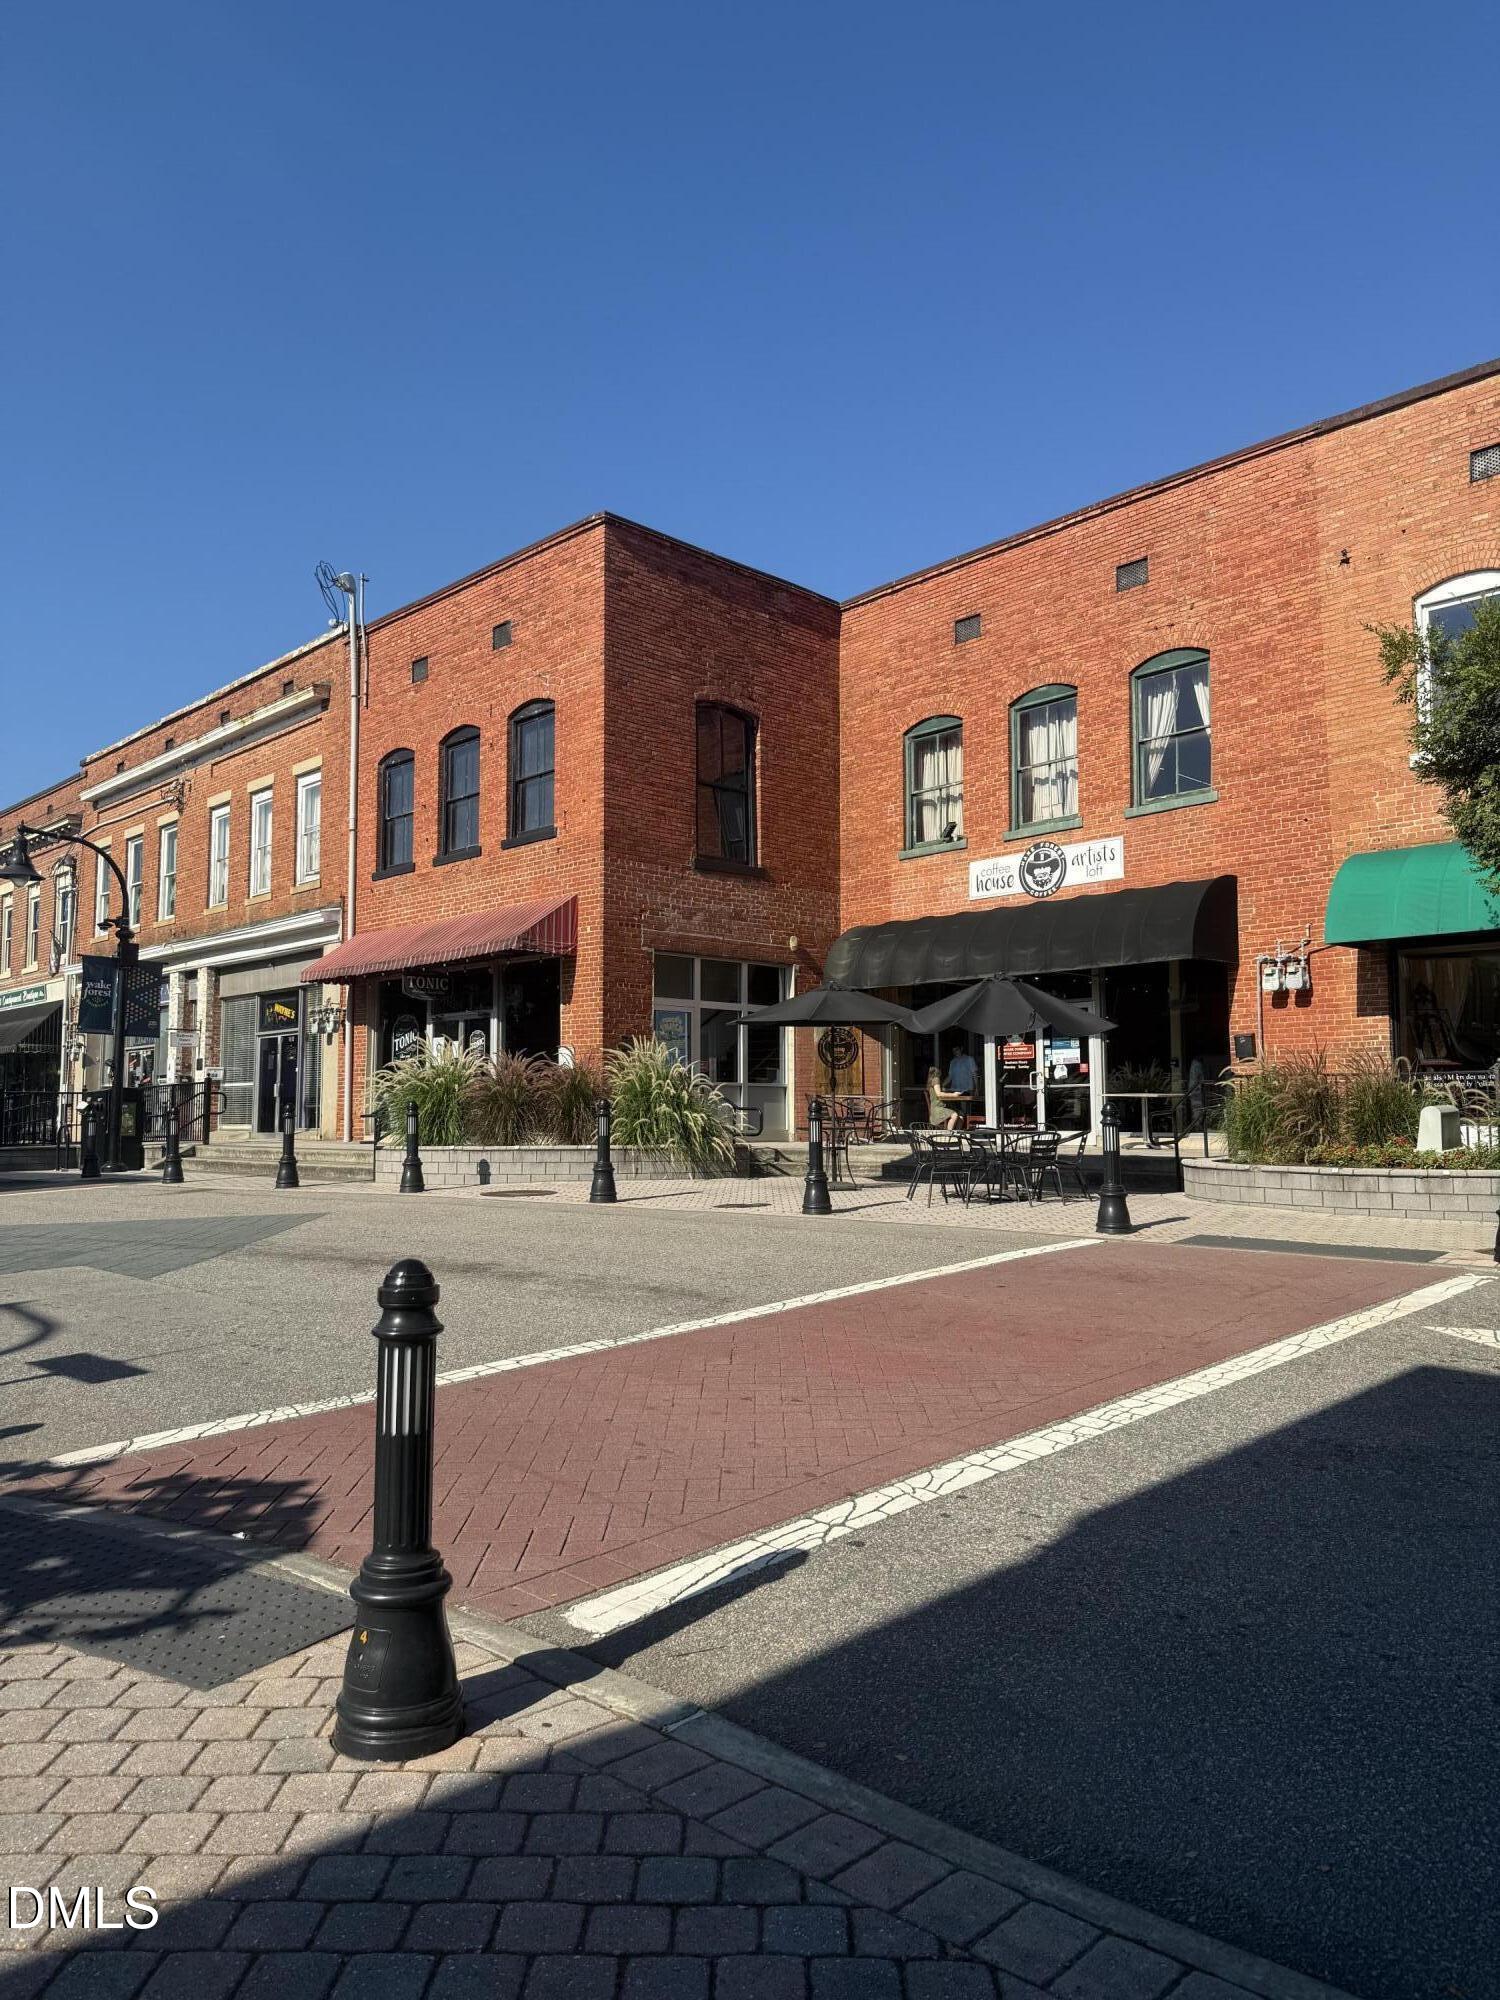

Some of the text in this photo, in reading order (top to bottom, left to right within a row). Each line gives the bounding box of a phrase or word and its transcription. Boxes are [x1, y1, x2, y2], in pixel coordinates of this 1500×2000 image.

[1071, 844, 1115, 866] artists
[980, 863, 1011, 877] coffee
[1086, 863, 1103, 877] loft
[976, 874, 1014, 892] house
[86, 979, 111, 989] wake
[406, 976, 449, 990] TONIC
[84, 985, 111, 999] forest
[394, 1029, 417, 1051] TONIC
[360, 1630, 369, 1644] 4
